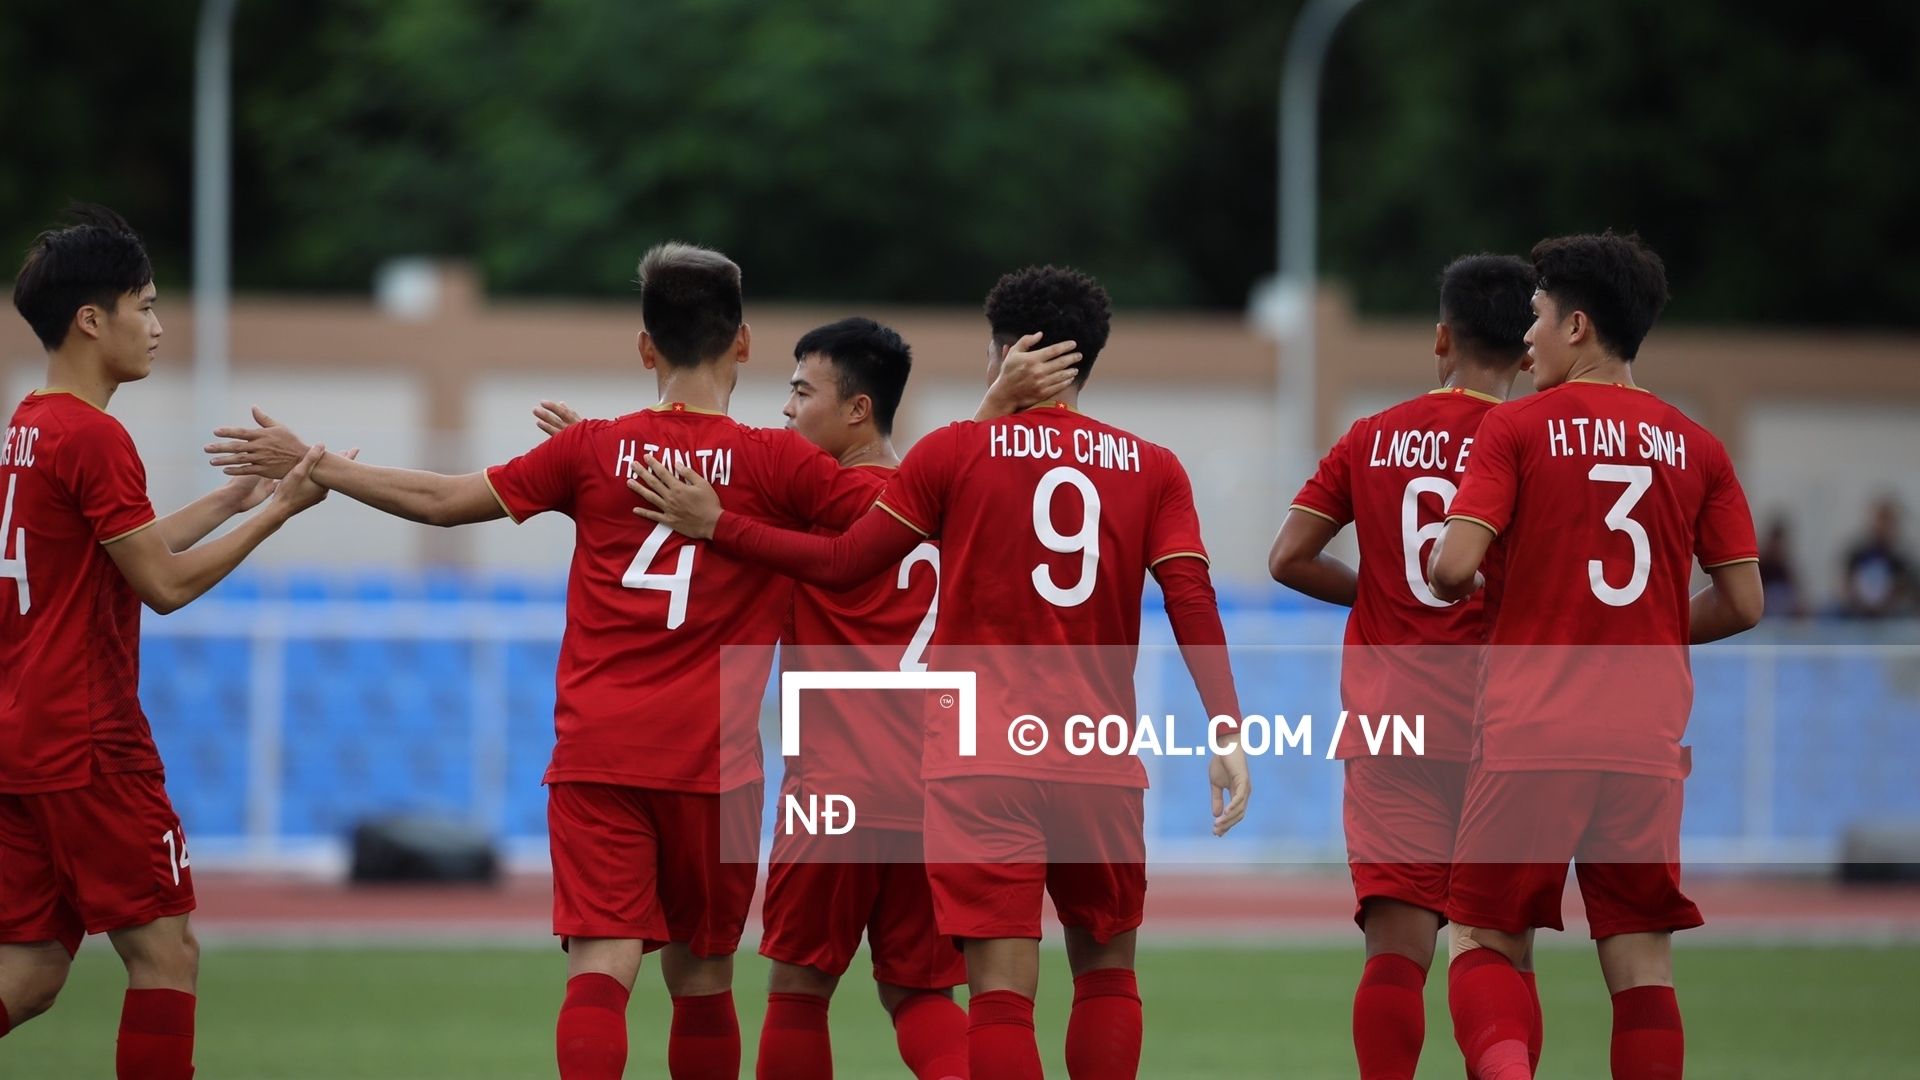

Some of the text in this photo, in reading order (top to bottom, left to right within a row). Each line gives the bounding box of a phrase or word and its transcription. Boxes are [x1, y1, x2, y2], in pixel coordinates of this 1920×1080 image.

[15, 425, 40, 468] DUC
[695, 447, 732, 486] TAI
[990, 424, 1141, 473] H.DUC CHINH
[1369, 429, 1450, 471] L.NGOC
[1547, 417, 1687, 471] H.TAN SINH
[1031, 466, 1101, 608] 9
[1401, 476, 1459, 608] 6
[1588, 463, 1653, 607] 3
[621, 522, 696, 631] 4
[897, 542, 941, 672] 2
